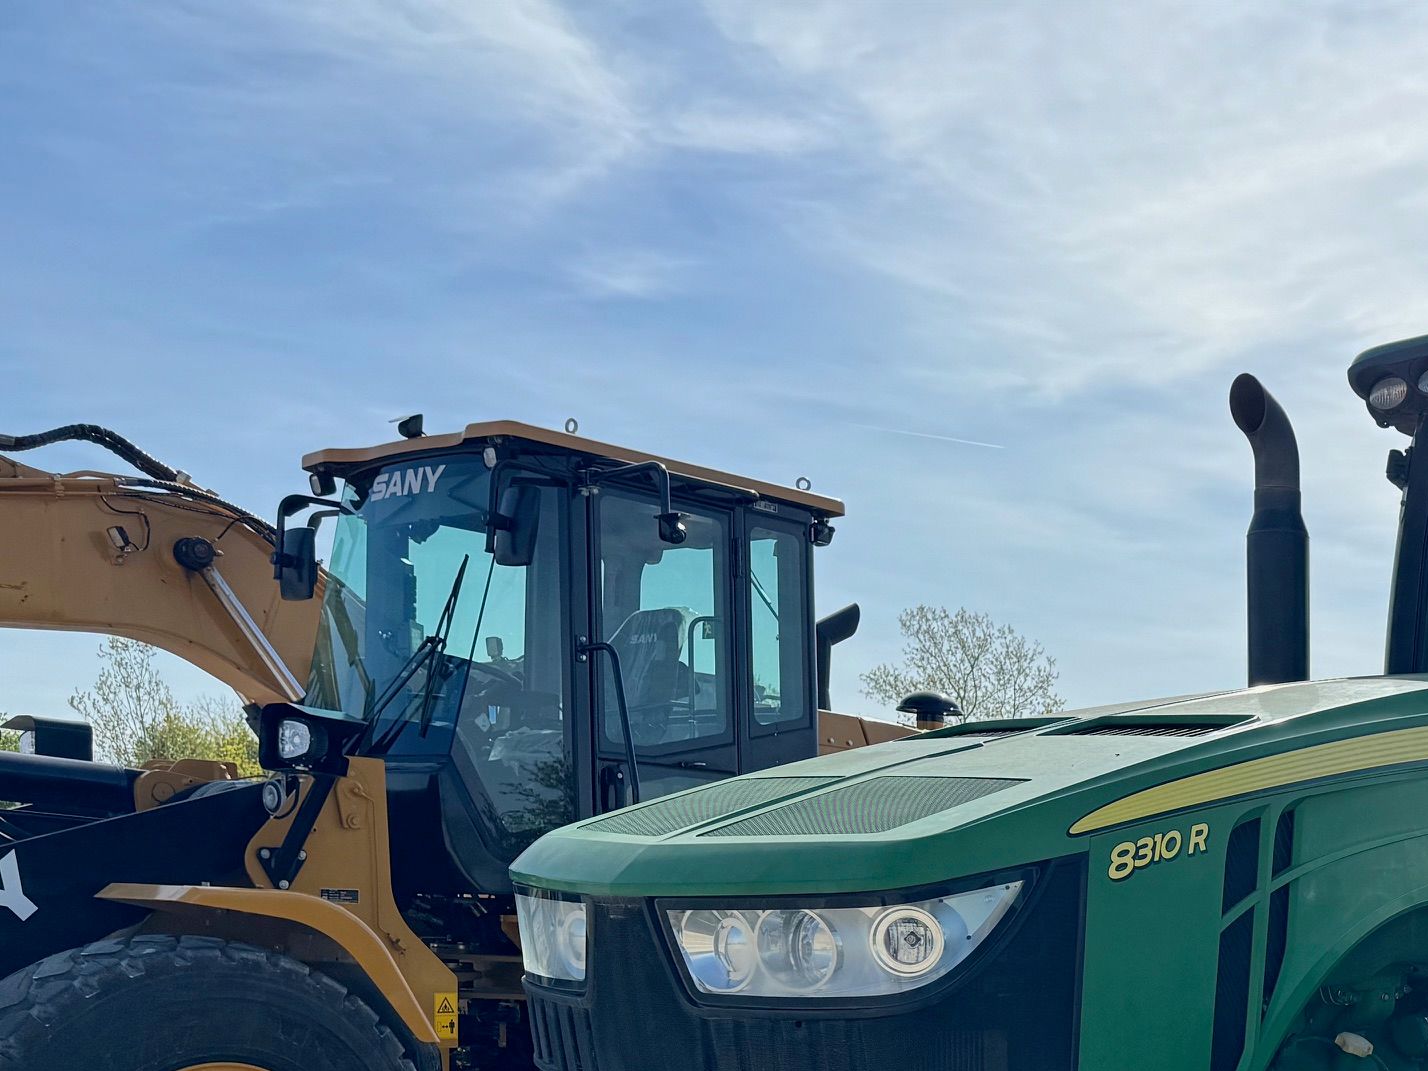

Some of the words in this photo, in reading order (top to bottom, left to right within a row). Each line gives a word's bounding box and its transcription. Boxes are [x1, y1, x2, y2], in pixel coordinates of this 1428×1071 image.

[370, 464, 447, 502] SANY
[1108, 829, 1182, 881] 8310
[1188, 822, 1209, 855] R
